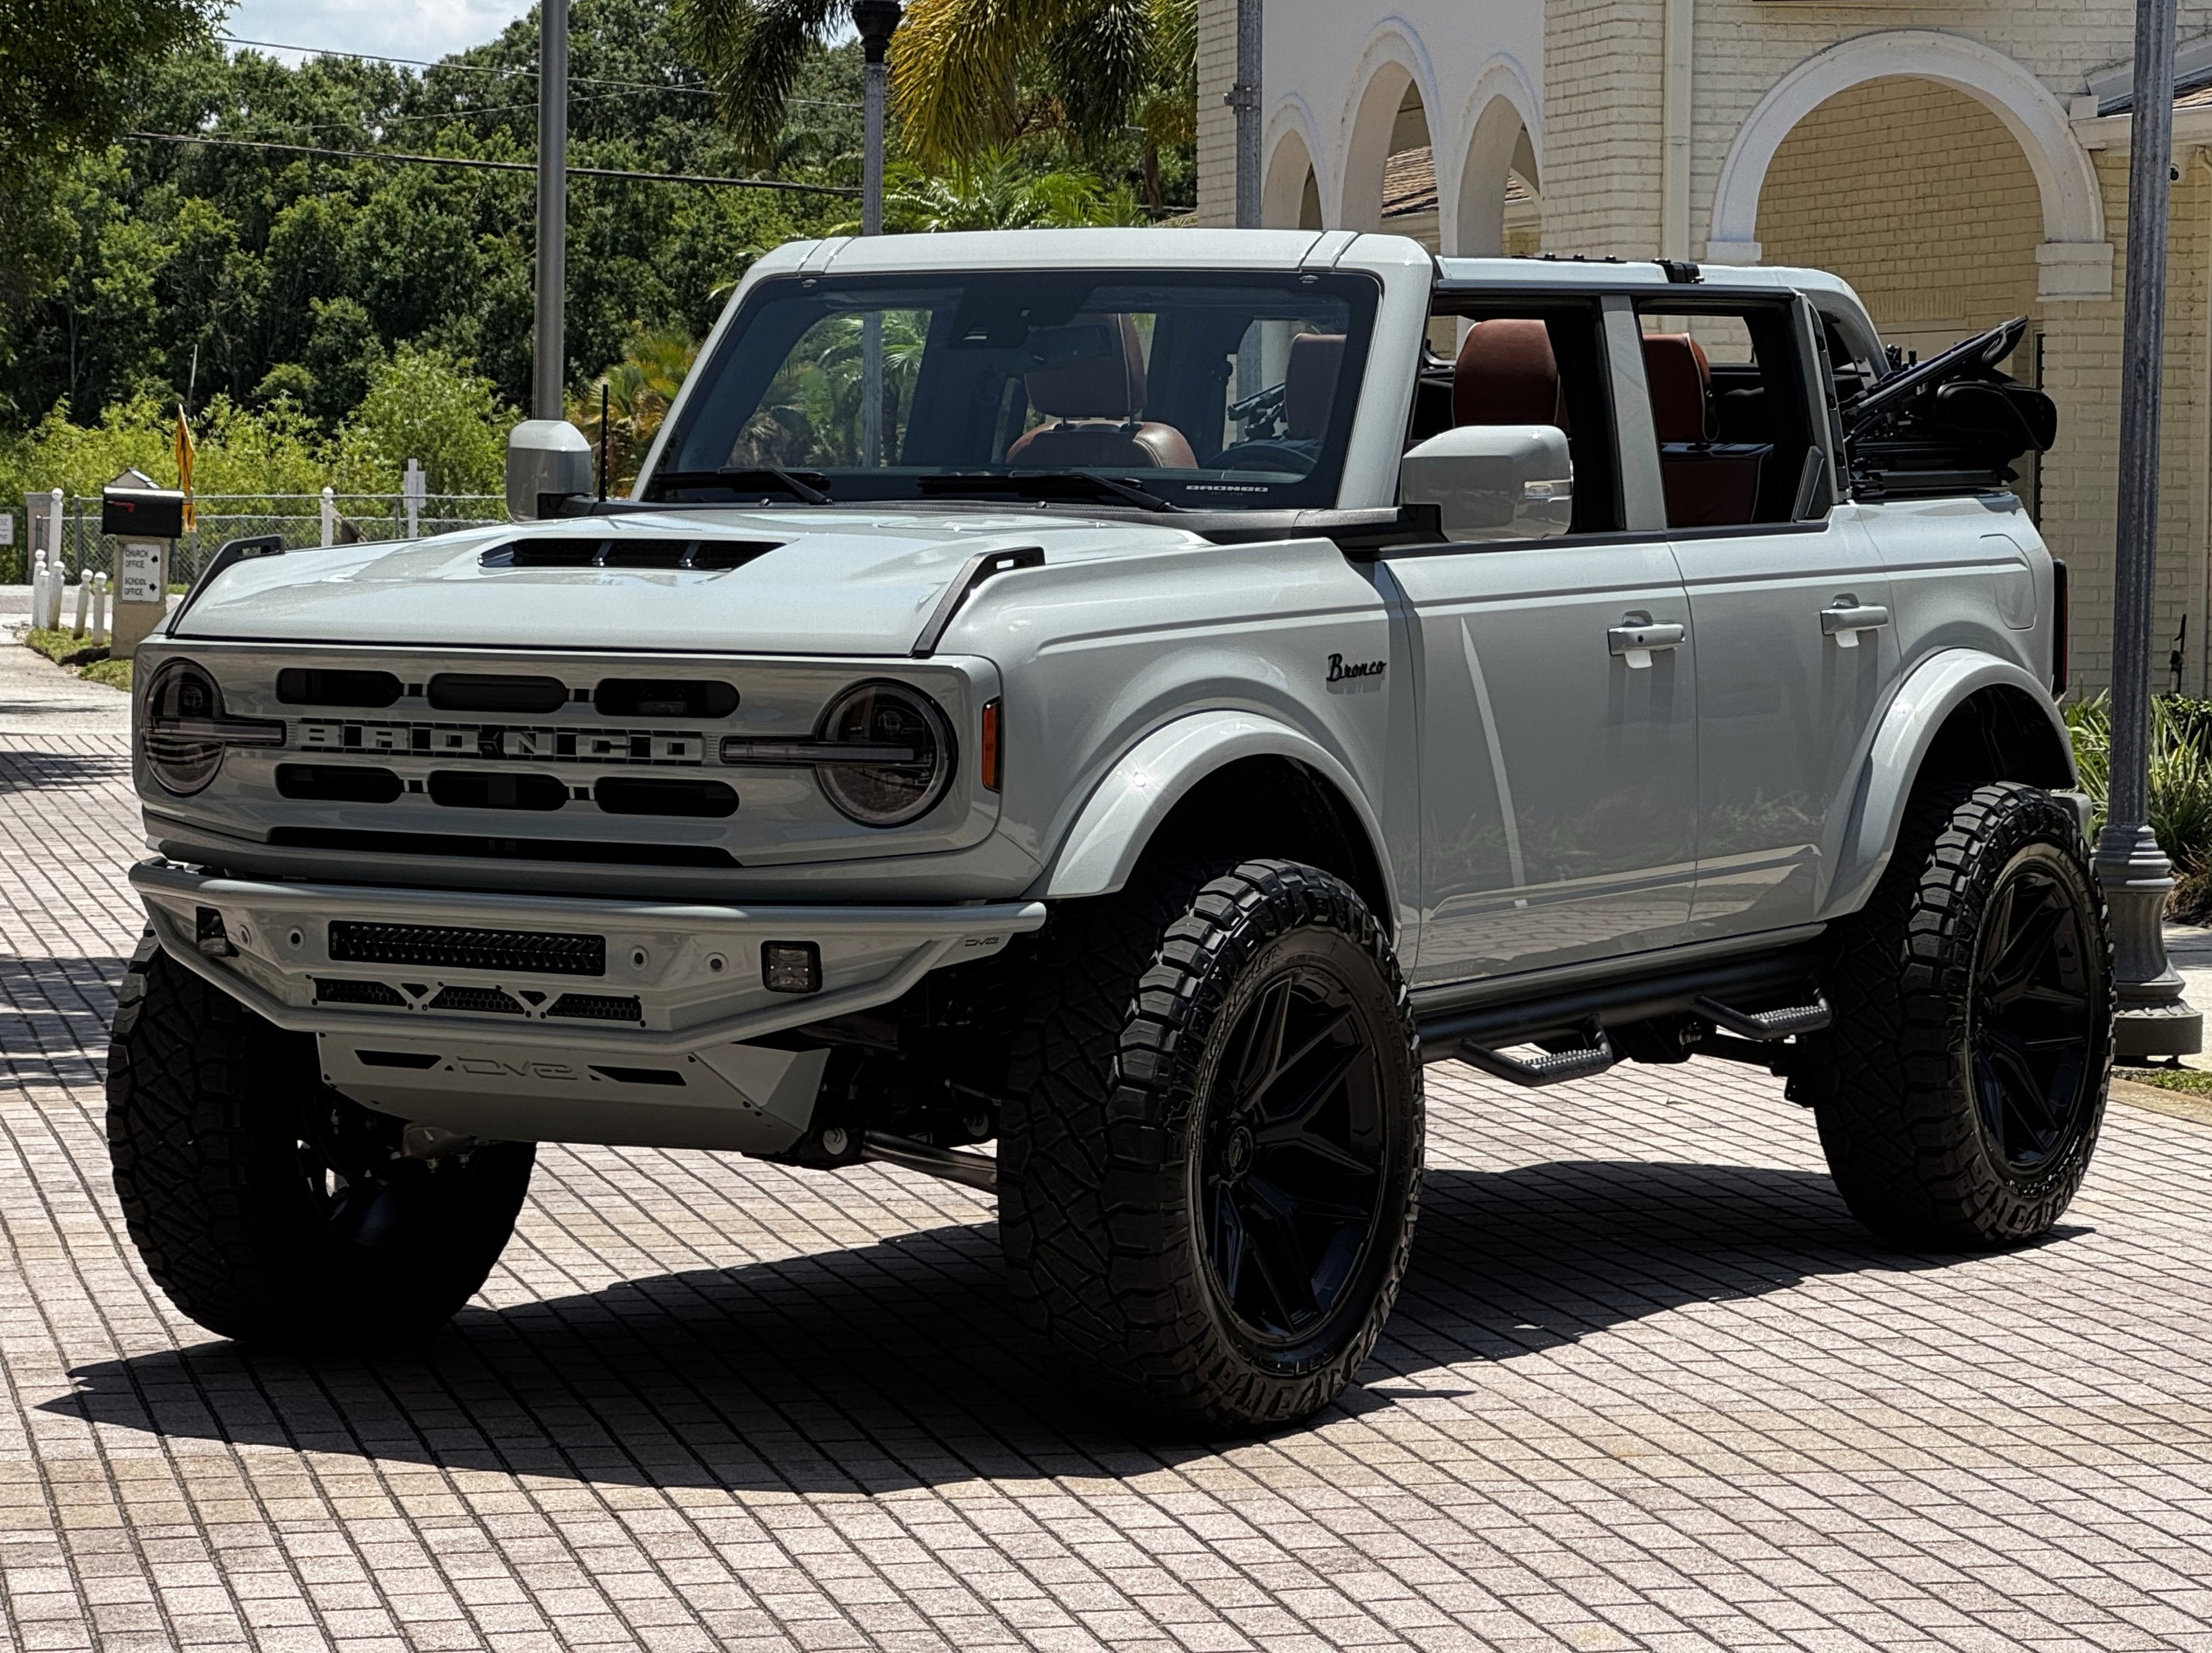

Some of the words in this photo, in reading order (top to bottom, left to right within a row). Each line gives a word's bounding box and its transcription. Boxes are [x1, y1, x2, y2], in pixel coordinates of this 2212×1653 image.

[125, 560, 144, 568] OFFICE
[124, 577, 147, 585] SCHOOL
[124, 588, 143, 596] OFFICE
[1326, 653, 1387, 682] Bronco
[298, 720, 704, 763] BRONCO
